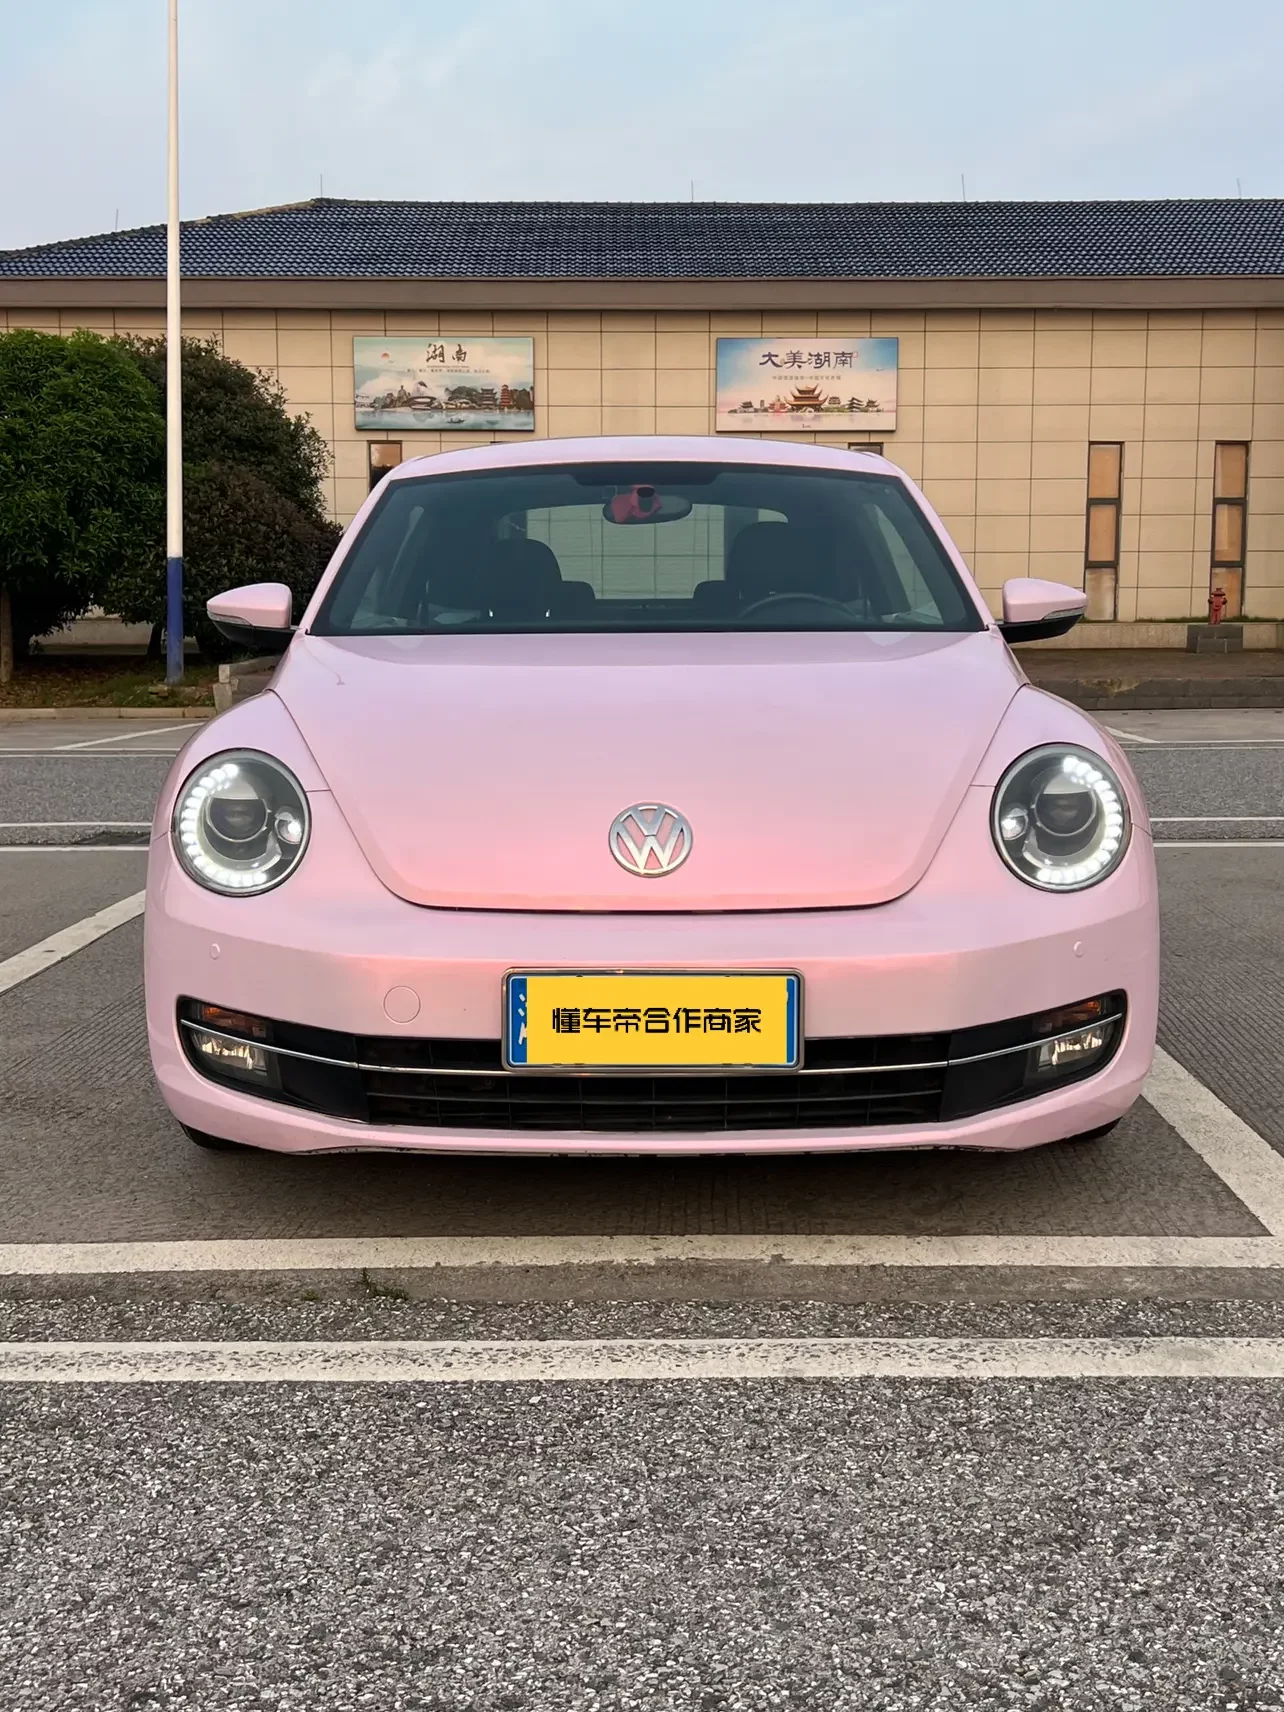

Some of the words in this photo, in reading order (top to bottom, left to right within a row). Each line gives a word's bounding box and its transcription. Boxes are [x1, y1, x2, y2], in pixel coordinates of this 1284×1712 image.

[425, 343, 467, 363] 湖南
[758, 350, 854, 370] 大美湖南
[610, 803, 691, 876] VW
